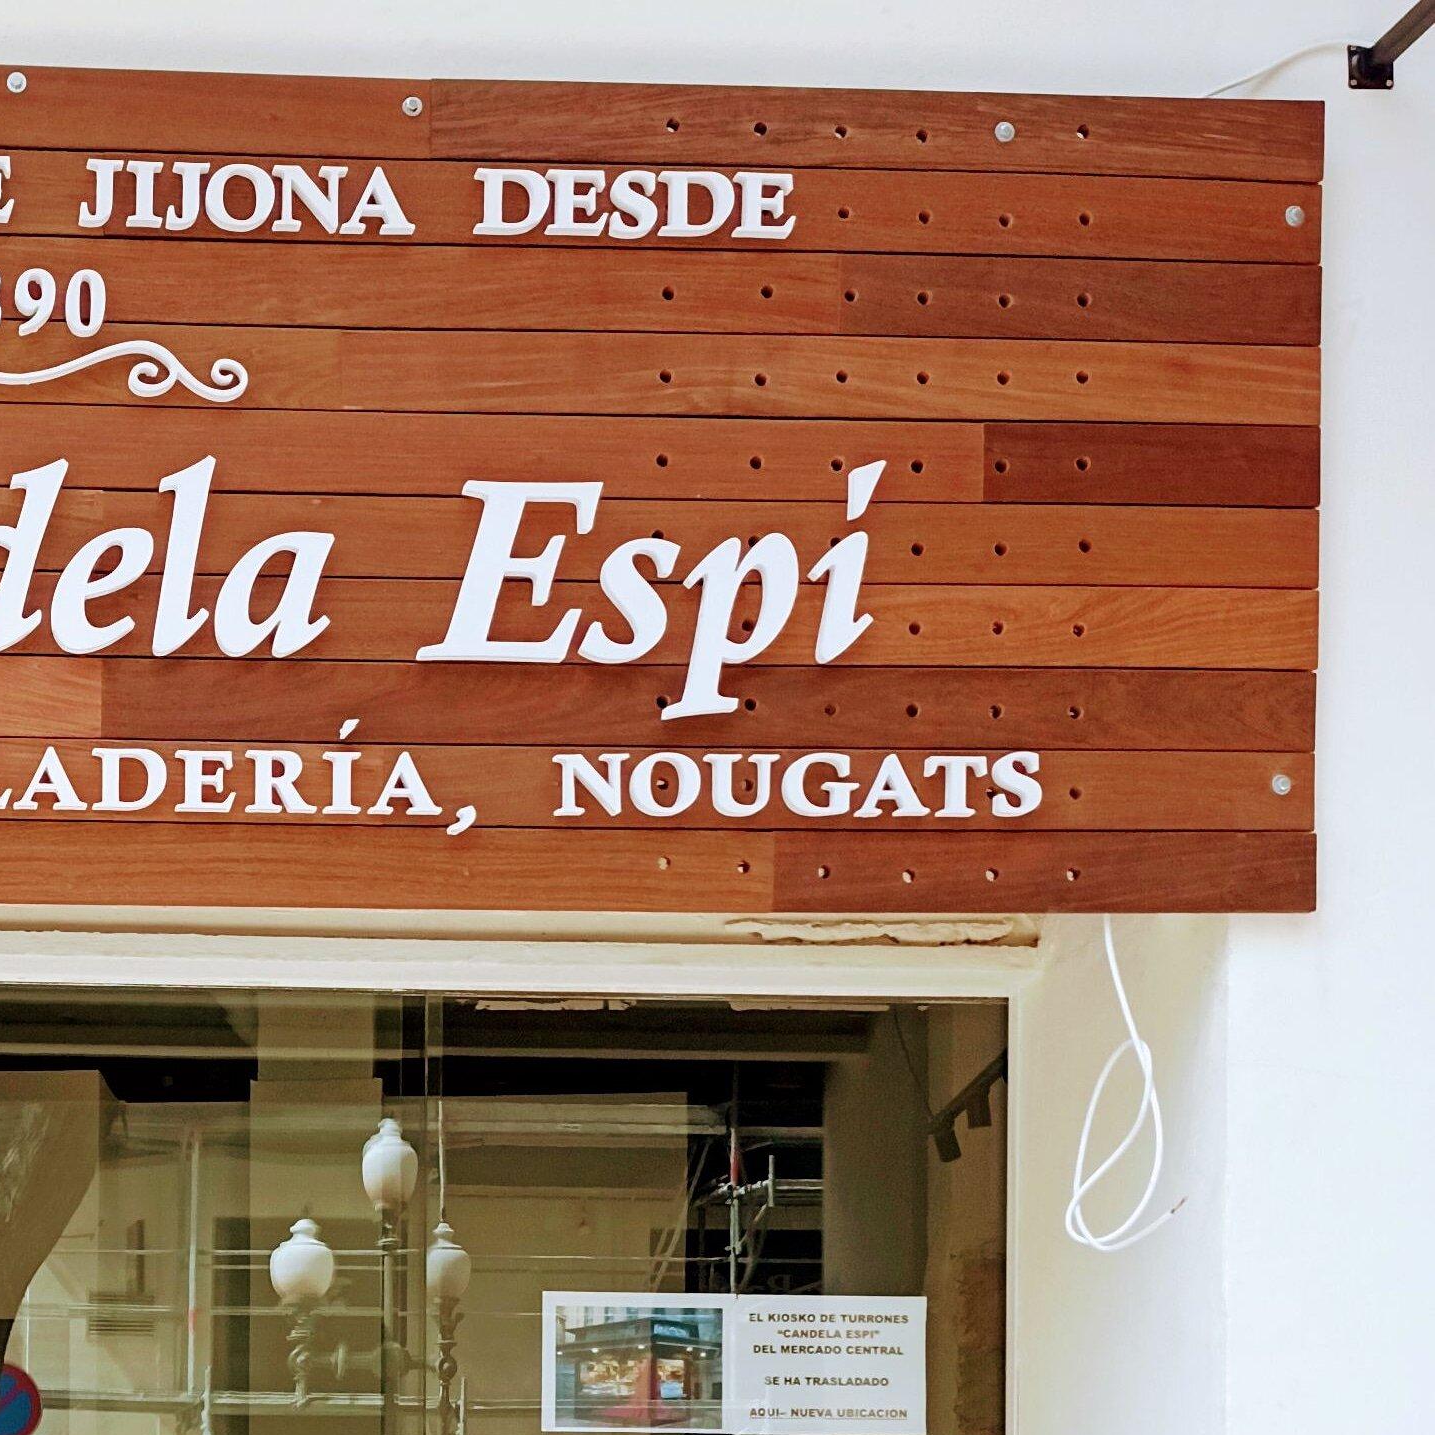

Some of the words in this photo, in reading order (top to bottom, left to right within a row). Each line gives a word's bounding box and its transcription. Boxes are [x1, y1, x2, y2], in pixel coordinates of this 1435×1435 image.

[78, 157, 416, 237] JIJONA
[473, 166, 797, 241] DESDE
[416, 459, 887, 720] Espí
[552, 749, 1043, 819] NOUGATS
[749, 1313, 765, 1324] EL
[768, 1313, 817, 1324] KIOSKO
[820, 1314, 837, 1324] DE
[839, 1314, 910, 1325] TURRONES
[752, 1345, 777, 1355] DEL
[780, 1345, 843, 1356] MERCADO
[845, 1346, 905, 1356] CENTRAL
[765, 1376, 781, 1387] SE
[784, 1376, 801, 1387] HA
[804, 1377, 890, 1388] TRASLADADO
[790, 1409, 834, 1419] NUEVA
[836, 1409, 909, 1420] UBICACION
